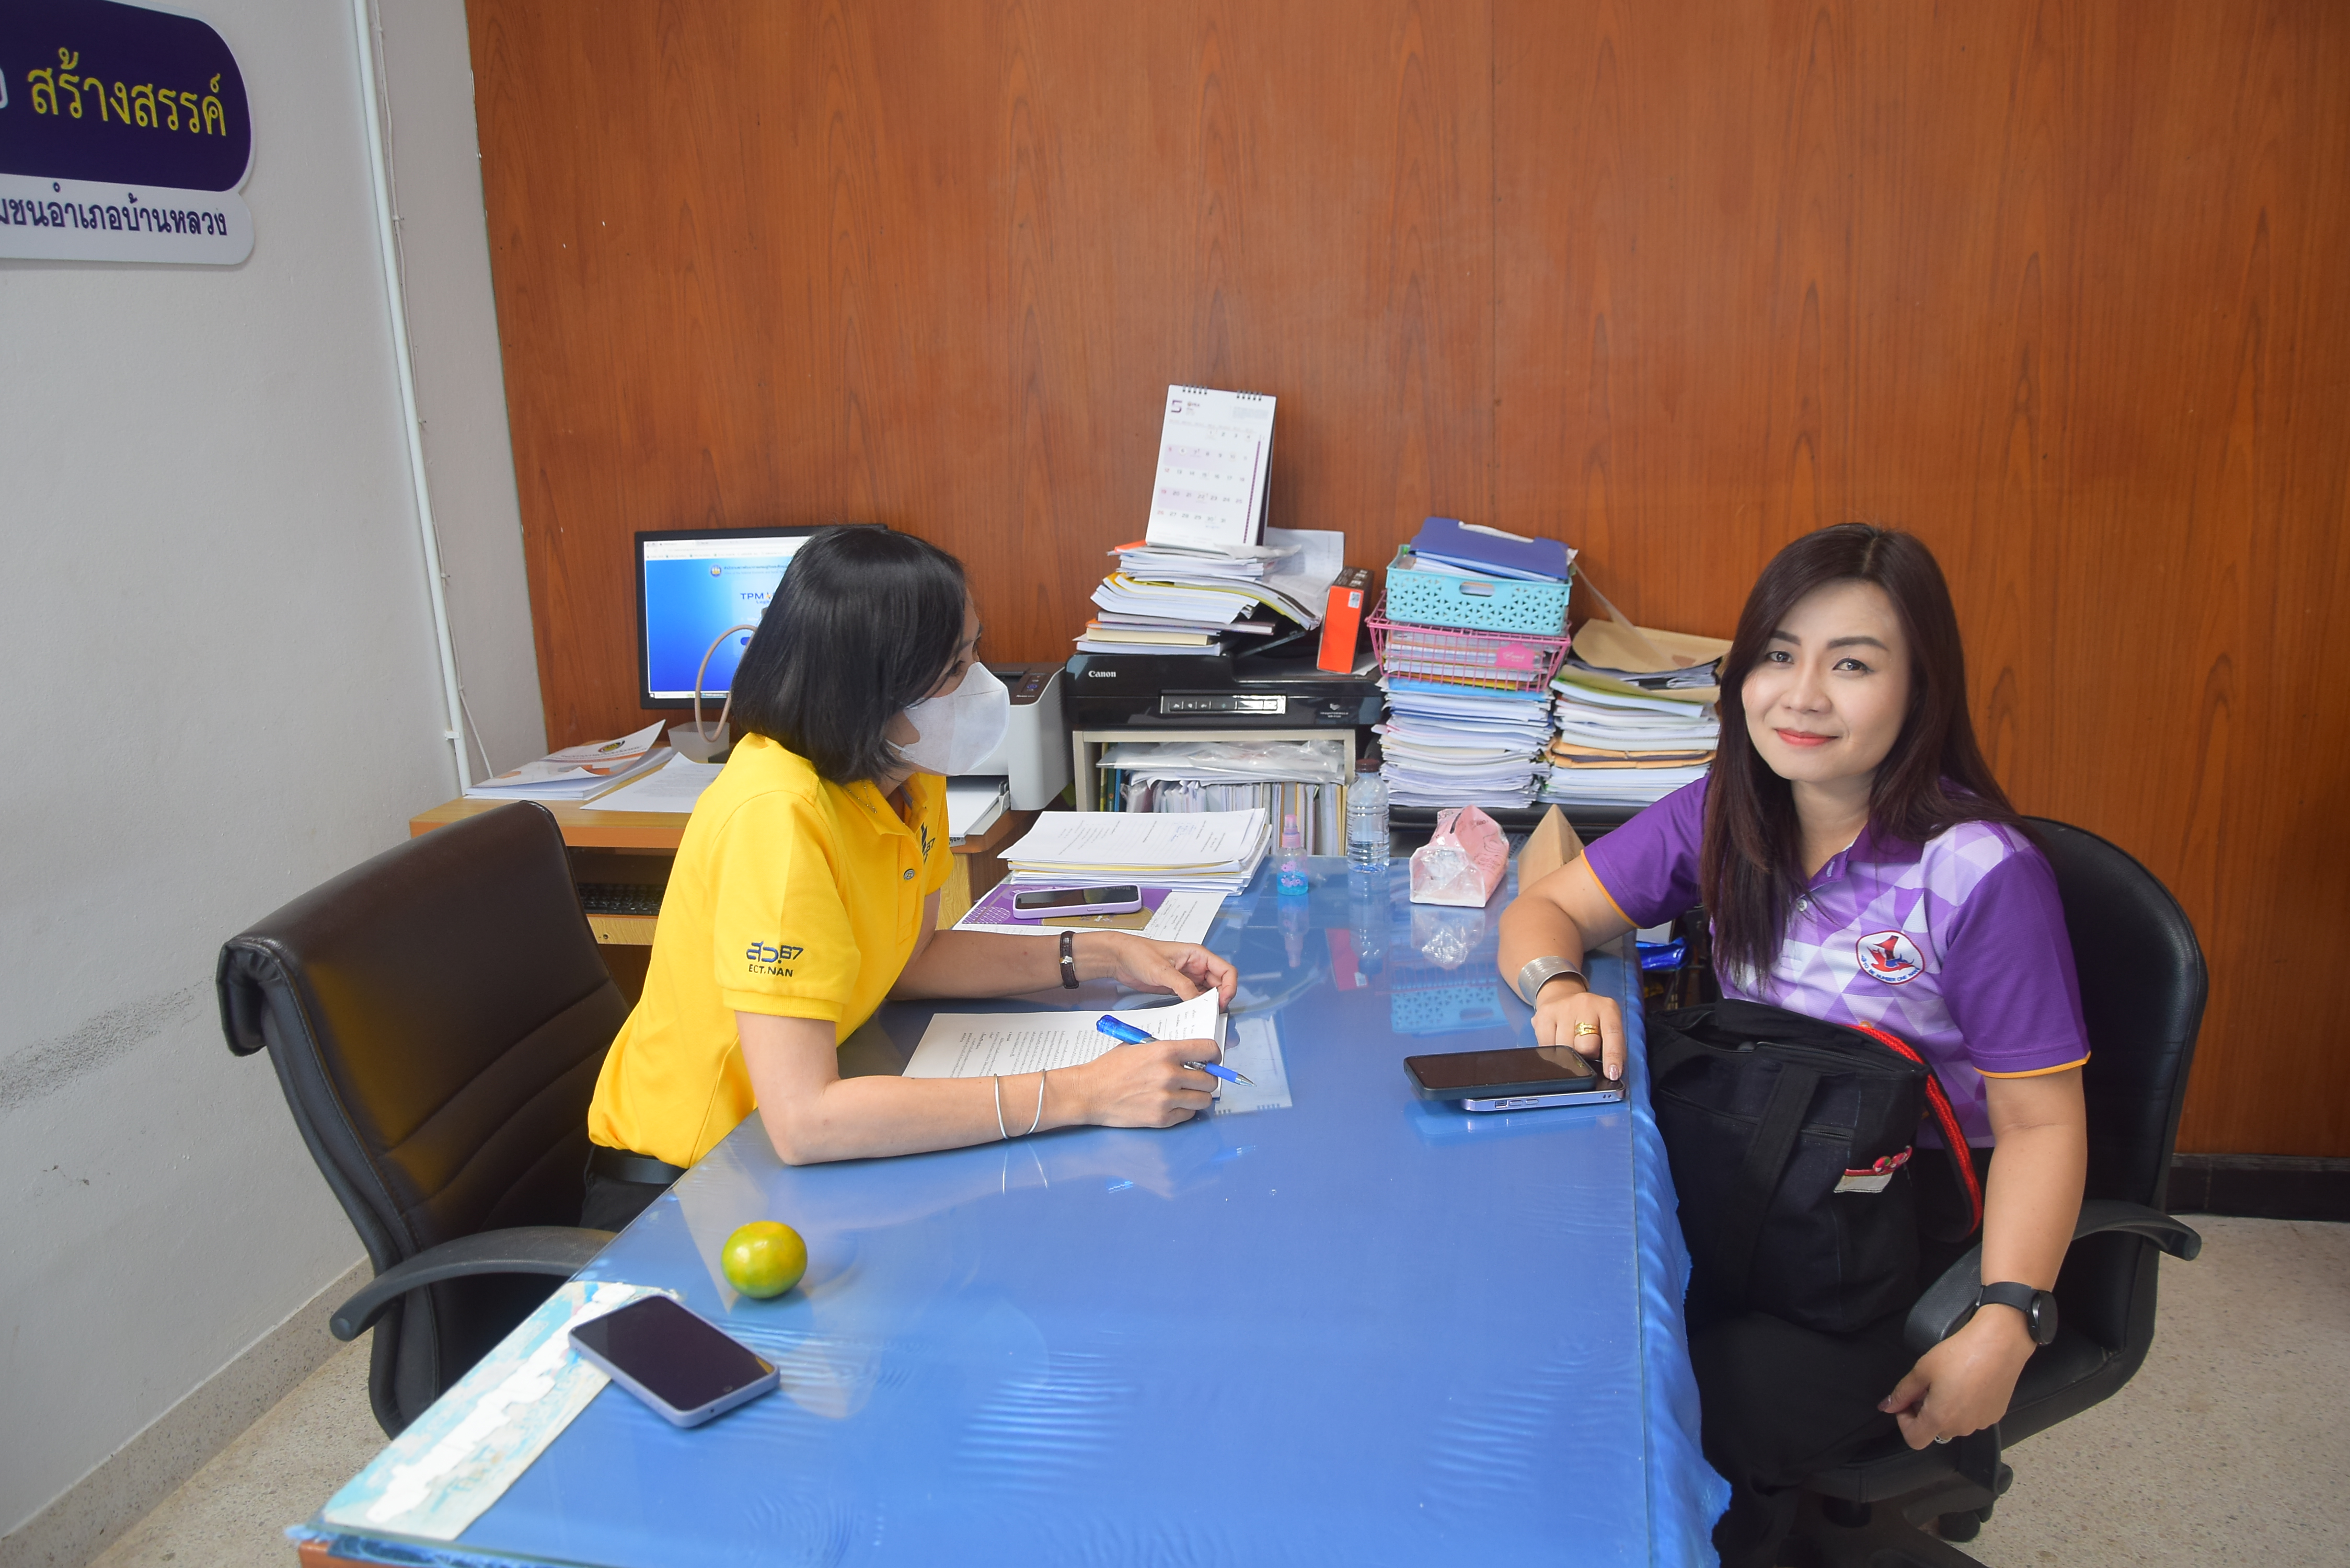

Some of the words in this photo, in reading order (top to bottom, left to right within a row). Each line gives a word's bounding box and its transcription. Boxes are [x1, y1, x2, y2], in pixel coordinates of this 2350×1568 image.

[27, 47, 226, 136] สร้างสรรค์
[1171, 400, 1182, 413] 5
